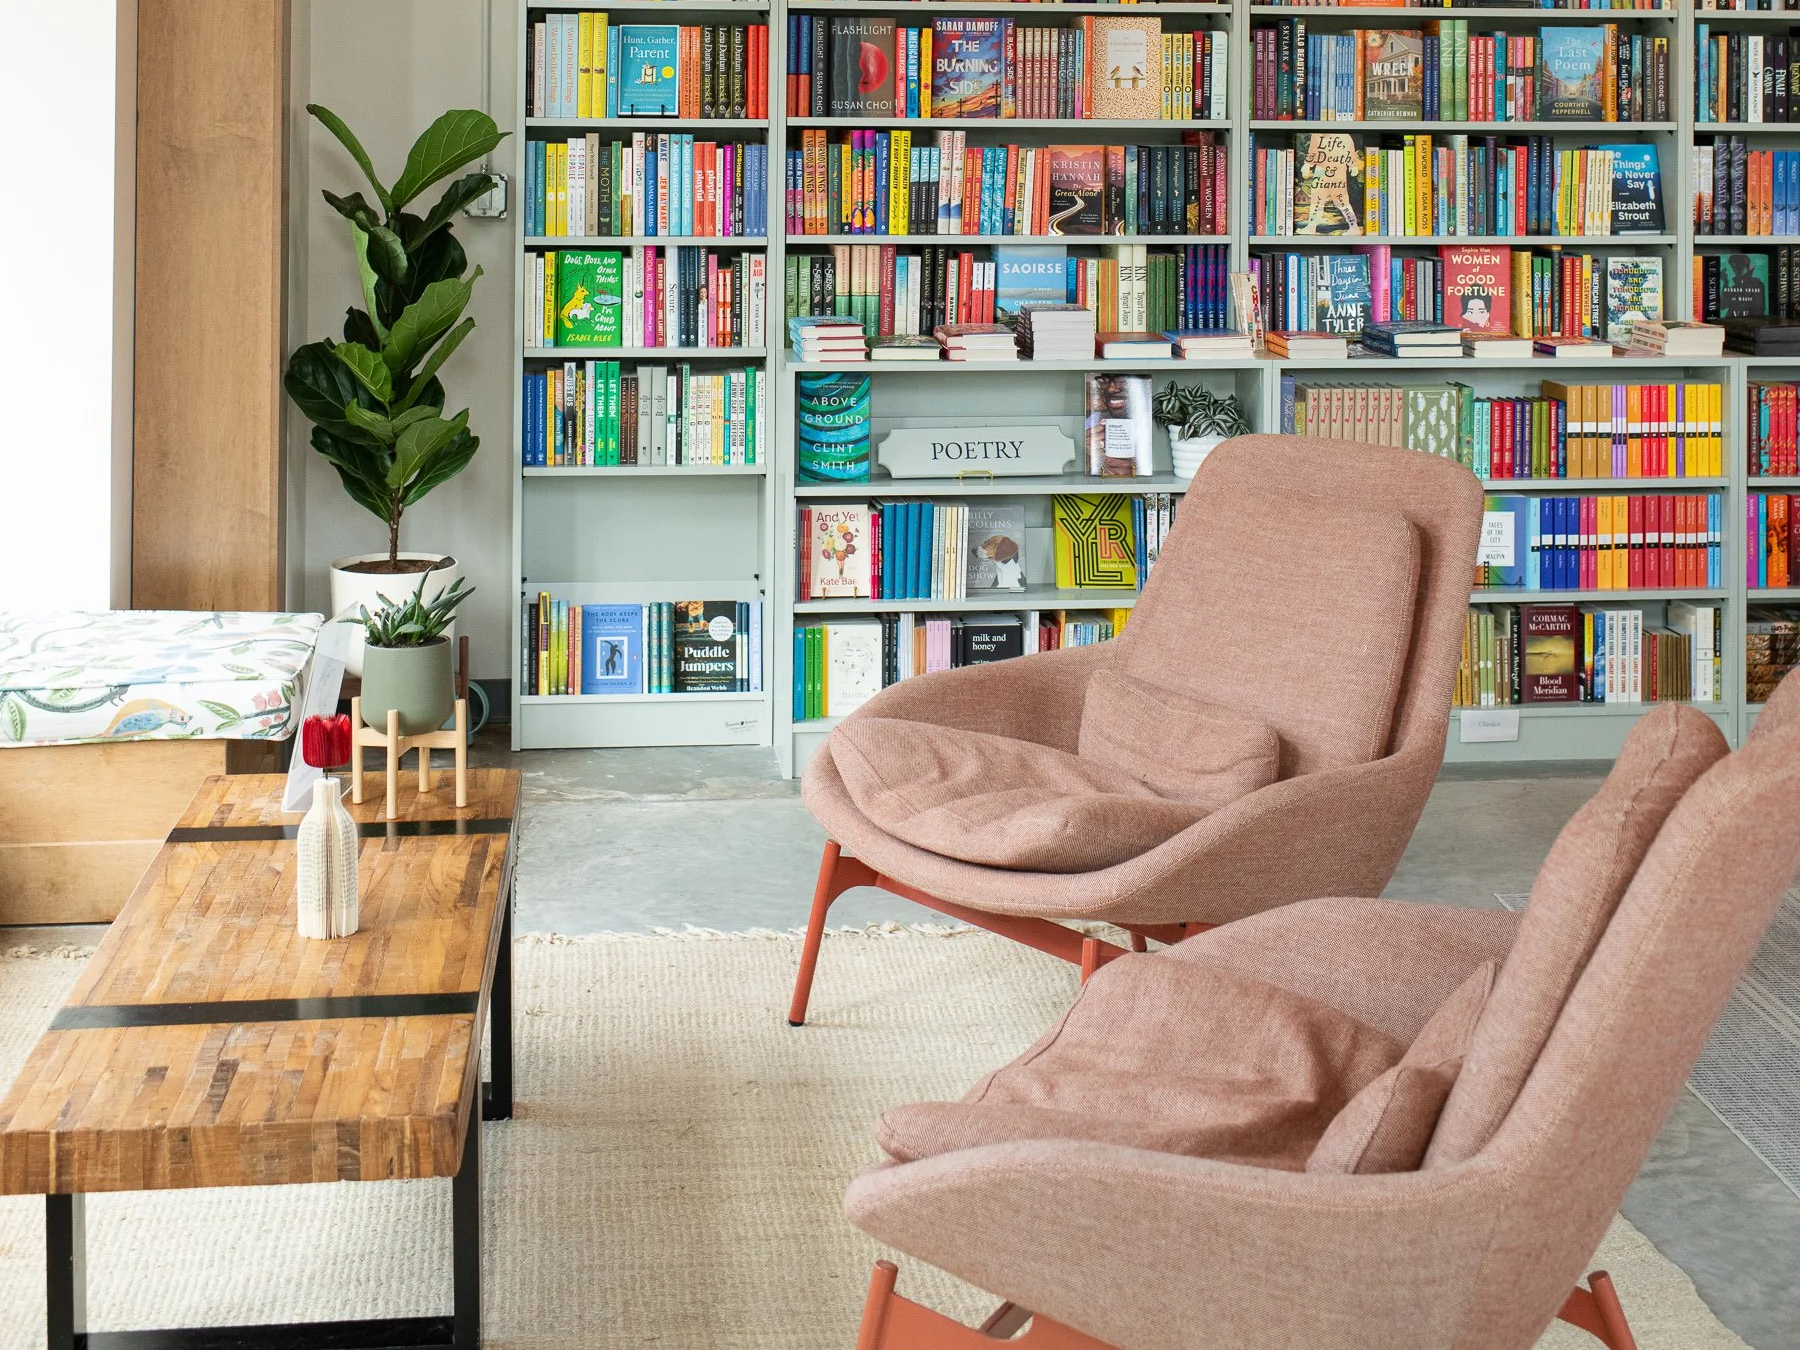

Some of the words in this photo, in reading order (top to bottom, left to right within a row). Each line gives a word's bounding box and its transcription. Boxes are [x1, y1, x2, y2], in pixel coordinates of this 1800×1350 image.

[832, 25, 892, 35] FLASHLIGHT
[936, 21, 964, 31] SARAH
[966, 21, 999, 31] DAMOFF
[623, 35, 645, 45] Hunt,
[648, 35, 676, 45] Gather,
[1565, 37, 1582, 46] The
[908, 31, 918, 64] AMERICAN
[951, 40, 980, 53] THE
[1454, 30, 1467, 67] LAND
[629, 47, 670, 59] Parent
[1559, 47, 1588, 58] Last
[936, 58, 998, 73] BURNING
[1371, 62, 1415, 77] WRECK
[1555, 59, 1591, 70] Poem
[908, 65, 917, 80] DIRT
[949, 80, 982, 95] SIDE
[831, 101, 864, 110] SUSAN
[866, 101, 892, 110] CHOI
[1367, 109, 1393, 117] CATHERINE
[1393, 109, 1417, 117] NEWMAN
[1317, 136, 1346, 151] Life,
[659, 138, 668, 162] AWAKE
[1305, 153, 1316, 163] &
[1316, 151, 1354, 164] Death,
[1052, 161, 1101, 169] KRISTIN
[1613, 160, 1647, 170] Things
[1324, 166, 1337, 177] &
[1627, 170, 1656, 180] Never
[1052, 173, 1101, 181] HANNAH
[600, 167, 610, 203] MOTH
[659, 175, 667, 190] JEN
[695, 170, 704, 202] playful
[706, 170, 716, 202] playful
[1310, 176, 1346, 189] Giants
[1626, 180, 1645, 190] Say
[1055, 189, 1076, 197] Great
[659, 192, 667, 230] HATMAKER
[1610, 201, 1656, 211] Elizabeth
[1618, 211, 1651, 221] Strout
[564, 254, 583, 266] DOGS,
[584, 254, 602, 265] BOYS,
[603, 257, 616, 265] AND
[754, 259, 762, 268] ON
[1451, 255, 1500, 264] WOMEN
[597, 266, 616, 274] OTHER
[1003, 263, 1062, 274] SAOIRSE
[1331, 258, 1356, 274] Three
[753, 269, 763, 277] AIR
[595, 275, 619, 284] THINGS
[1331, 274, 1352, 290] Days
[1352, 275, 1362, 283] in
[1457, 275, 1496, 284] GOOD
[1628, 276, 1643, 284] AND
[1447, 286, 1506, 296] FORTUNE
[1612, 286, 1659, 294] TOMORROW,
[1334, 291, 1360, 301] June
[1628, 295, 1643, 303] AND
[601, 305, 613, 314] I'VE
[1326, 302, 1365, 319] ANNE
[1613, 304, 1658, 312] TOMORROW
[594, 313, 615, 324] CRIED
[1322, 317, 1365, 333] TYLER
[566, 334, 592, 342] ISABEL
[593, 334, 613, 342] KLEE
[811, 396, 858, 407] ABOVE
[804, 413, 864, 425] GROUND
[813, 443, 855, 453] CLINT
[931, 440, 1024, 461] POETRY
[812, 460, 856, 471] SMITH
[816, 511, 840, 523] And
[841, 511, 861, 523] Yet
[968, 511, 994, 520] BILLY
[968, 520, 1012, 529] COLLINS
[1487, 521, 1504, 530] TALES
[1489, 536, 1502, 544] CITY
[968, 564, 989, 573] DOG
[819, 576, 840, 586] Kate
[968, 572, 996, 580] SHOW
[1532, 614, 1568, 623] CORMAC
[1528, 623, 1572, 631] McCARTHY
[972, 633, 990, 642] milk
[991, 633, 1007, 642] and
[684, 646, 730, 658] Puddle
[972, 642, 996, 652] honey
[680, 660, 734, 674] Jumpers
[1539, 676, 1562, 685] Blood
[1533, 686, 1568, 695] Meridian
